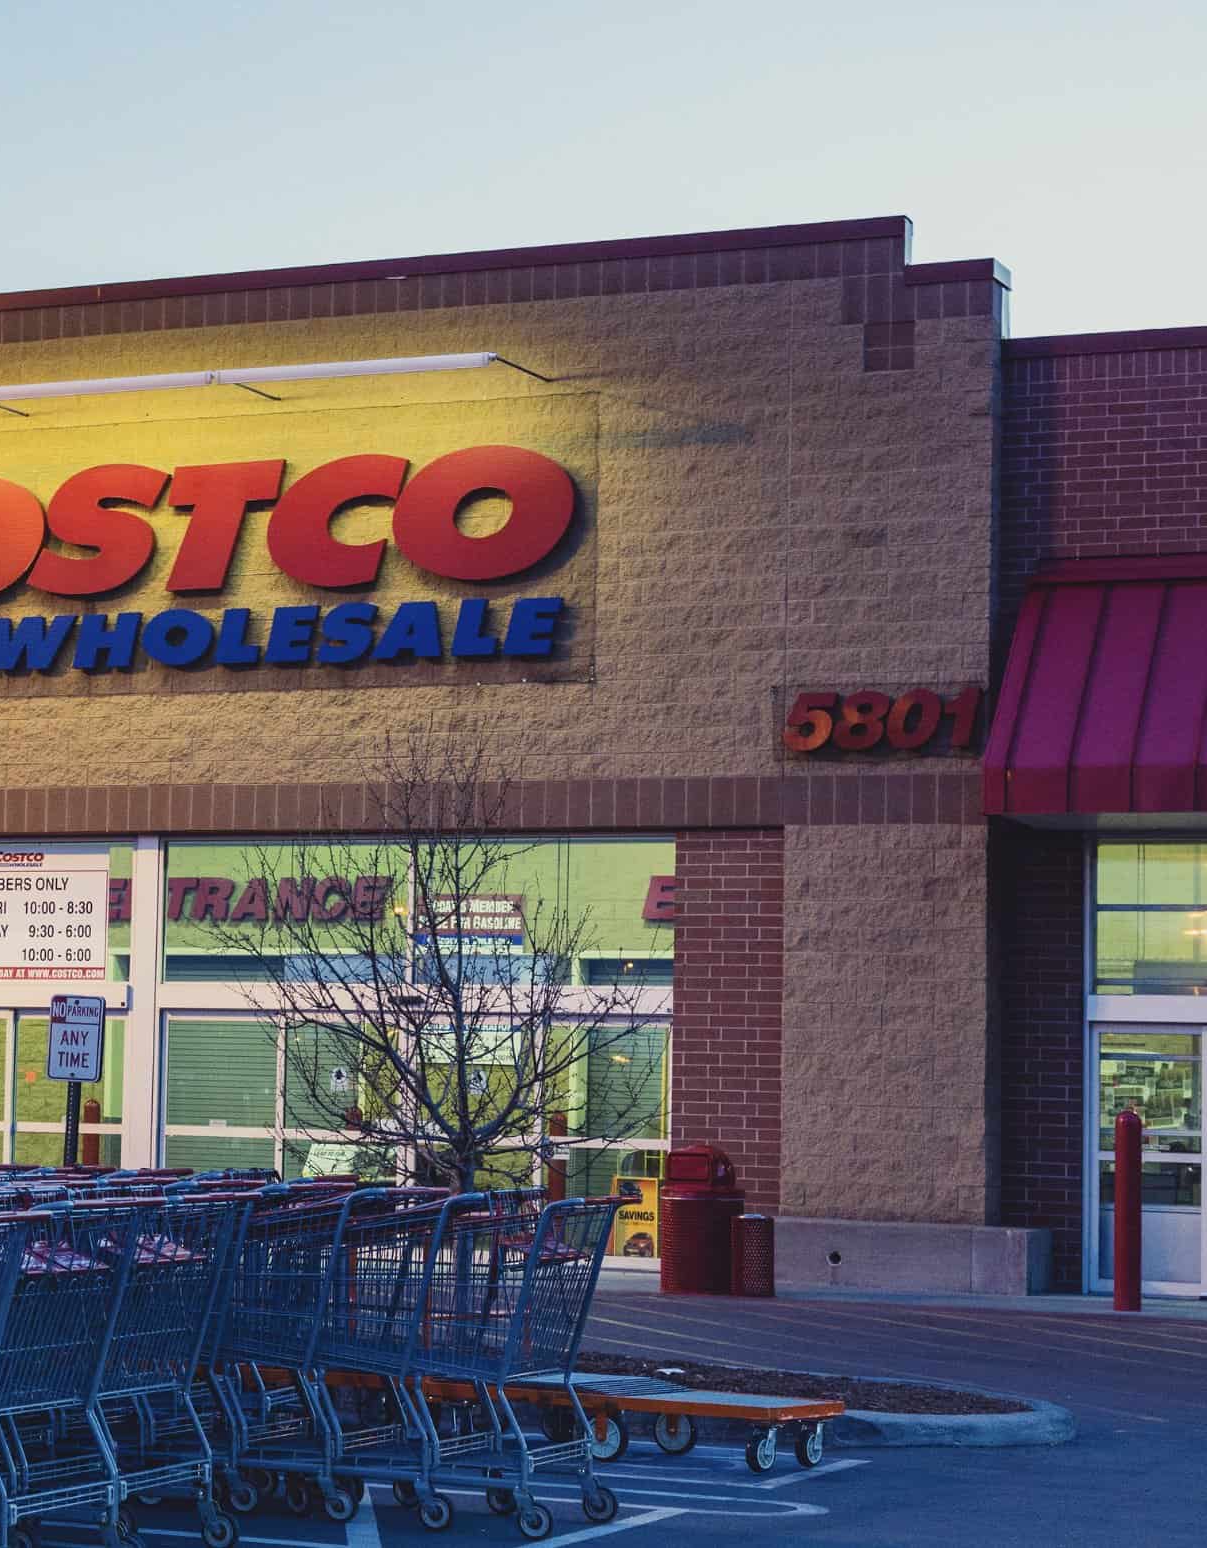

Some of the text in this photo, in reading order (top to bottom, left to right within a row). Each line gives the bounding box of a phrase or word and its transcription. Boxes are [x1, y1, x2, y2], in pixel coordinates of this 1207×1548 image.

[783, 687, 983, 751] 5801
[35, 877, 69, 891] ONLY
[24, 901, 55, 914] 10:00
[67, 901, 93, 914] 8:30
[28, 925, 54, 937] 9:30
[66, 925, 91, 937] 6:00
[22, 949, 53, 961] 10:00
[65, 949, 91, 961] 6:00
[16, 970, 25, 978] AT
[28, 969, 105, 978] WWW.COSTCO.COM
[53, 1001, 99, 1017] NO PARKING
[60, 1030, 89, 1046] ANY
[58, 1051, 90, 1068] TIME
[619, 1210, 654, 1221] SAVINGS
